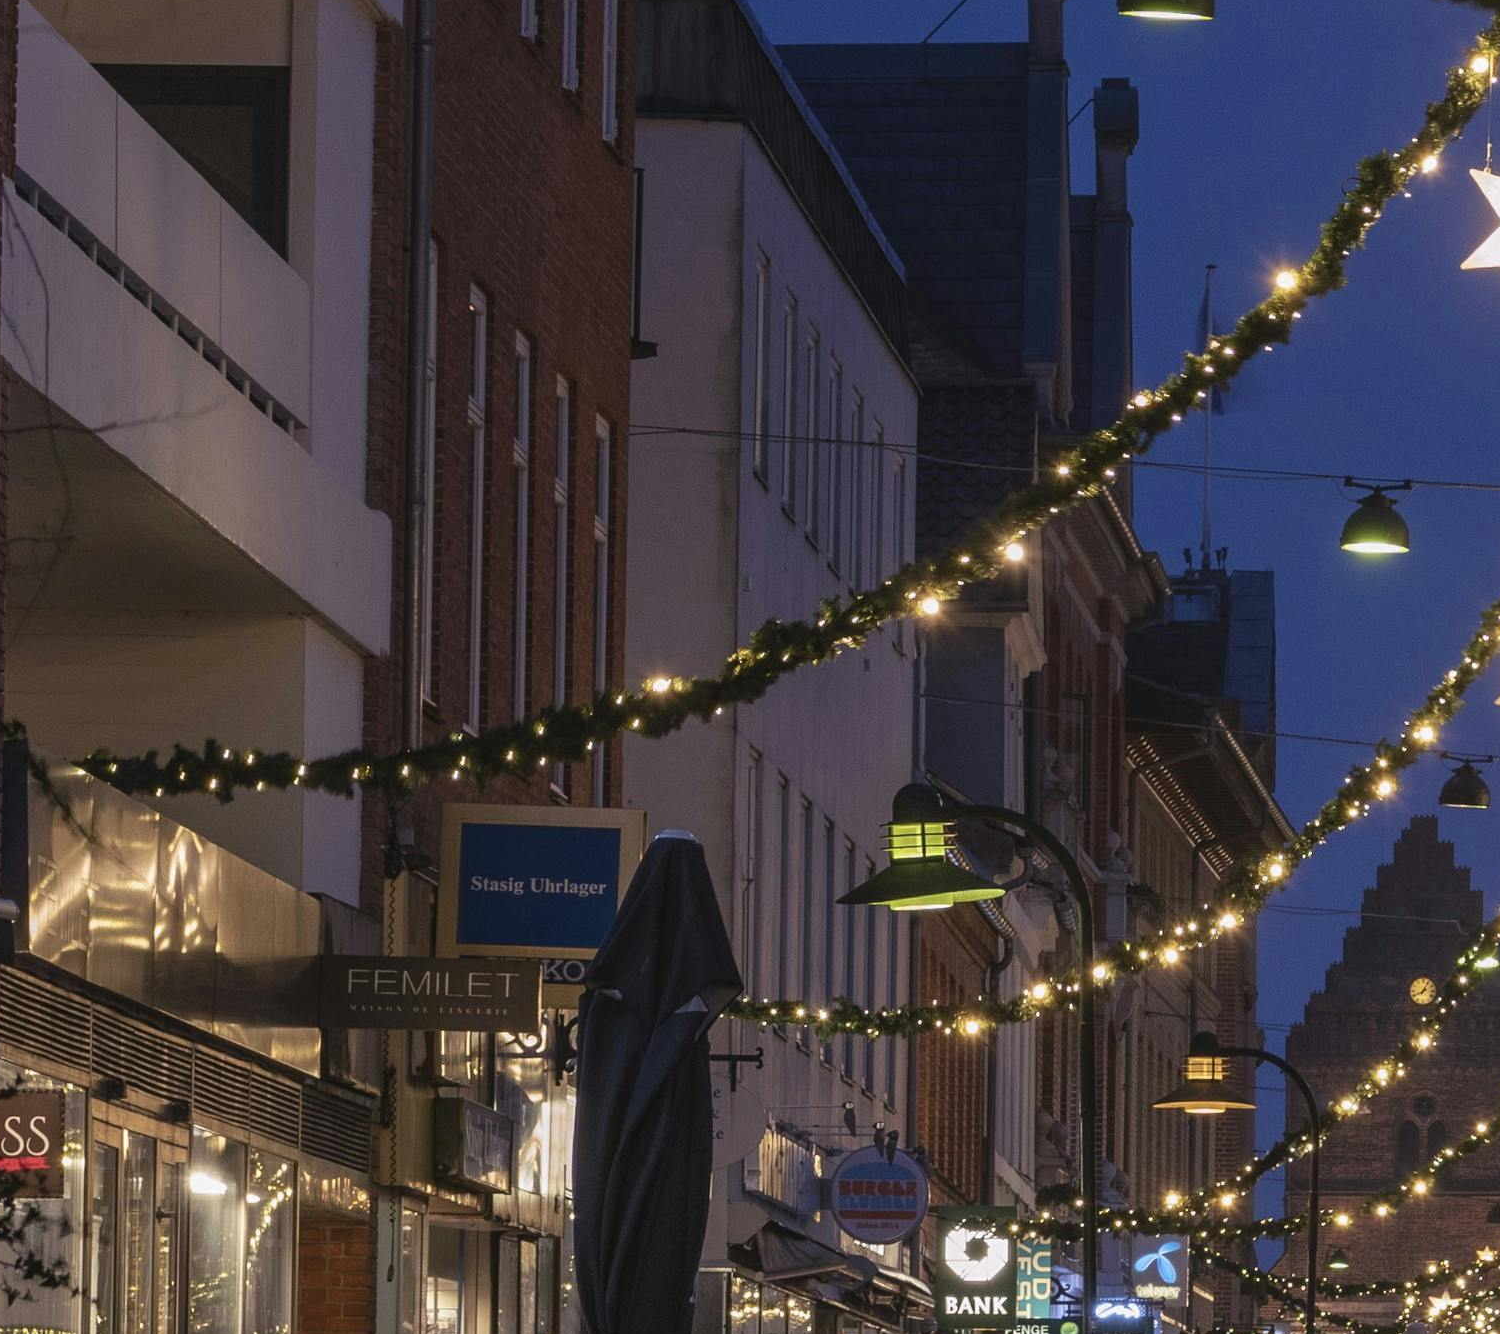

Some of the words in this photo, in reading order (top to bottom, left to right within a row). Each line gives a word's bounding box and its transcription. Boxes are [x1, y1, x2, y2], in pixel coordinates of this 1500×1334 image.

[471, 875, 524, 896] Stasig
[529, 876, 607, 897] Uhrlager
[347, 969, 520, 998] FEMILET
[349, 1004, 402, 1013] MAISON
[439, 1005, 510, 1015] LINGERIE
[839, 1180, 917, 1196] BURGER
[945, 1296, 1008, 1315] BANK
